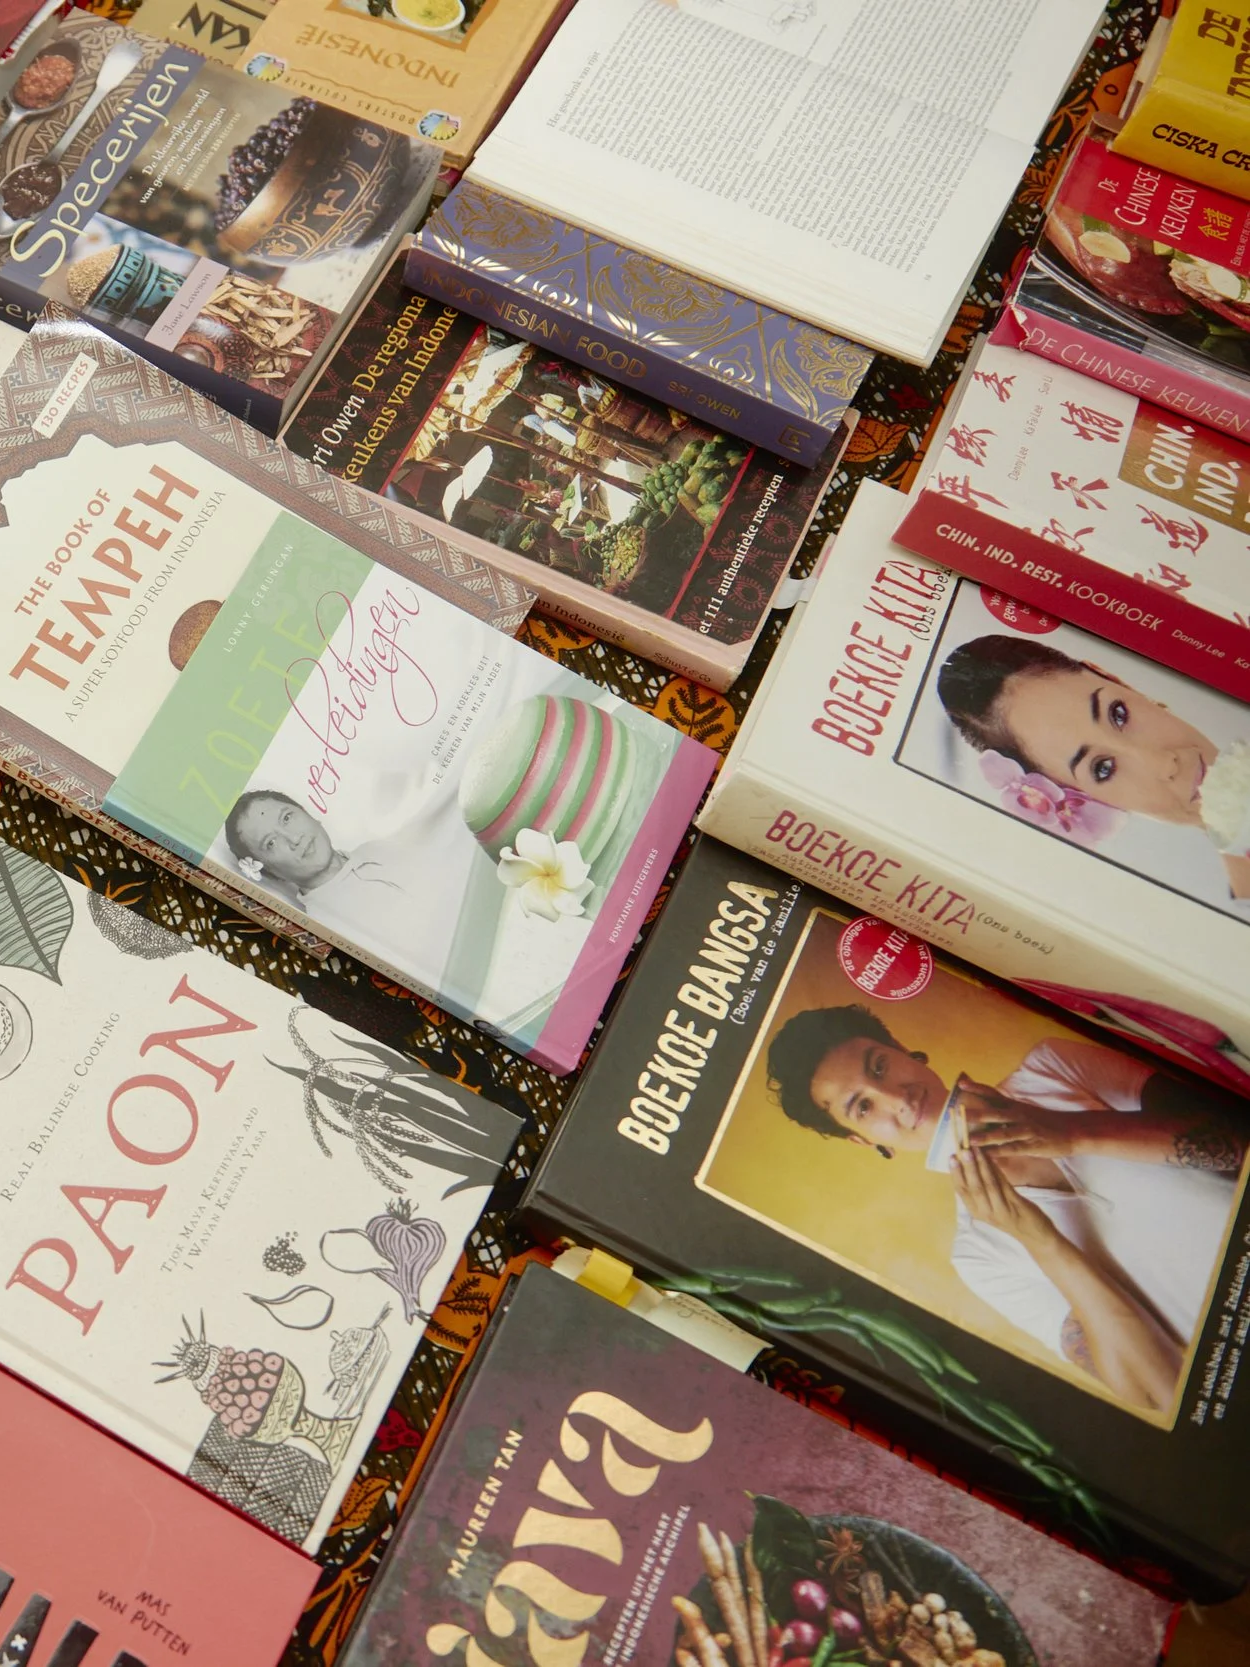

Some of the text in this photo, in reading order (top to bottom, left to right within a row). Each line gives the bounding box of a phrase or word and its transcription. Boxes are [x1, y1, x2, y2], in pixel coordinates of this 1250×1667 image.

[294, 22, 460, 90] INDONESIË
[1197, 8, 1241, 48] DE
[9, 61, 190, 278] Specerijen
[139, 186, 156, 205] van
[141, 158, 159, 176] De
[1098, 177, 1119, 194] DE
[1152, 123, 1219, 160] CISKA
[1114, 166, 1161, 226] CHINESE
[1158, 183, 1198, 241] KEUKEN
[423, 265, 571, 347] INDONESIAN
[575, 332, 648, 380] FOOD
[696, 394, 742, 421] OWEN
[1027, 327, 1247, 432] DE CHINESE KEUKEN
[40, 405, 61, 428] 130
[8, 464, 200, 691] TEMPEH
[14, 487, 112, 618] THE BOOK OF
[65, 488, 227, 722] A SUPER SOYFOOD FROM INDONESIA
[223, 542, 294, 654] LONNY GERUNGAN
[811, 559, 943, 757] BOEKOE KITA
[1066, 580, 1164, 633] KOOKBOEK
[1171, 628, 1206, 655] Danny
[1206, 641, 1227, 659] Lee
[178, 610, 330, 815] ZOETE
[431, 655, 491, 758] CAKES EN KOEKJES UIT
[432, 660, 504, 786] DE KEUKEN VAN MIJN VADER
[17, 770, 76, 811] BOOK
[78, 807, 108, 828] OF
[110, 827, 196, 883] TEMPEH
[609, 848, 659, 944] FONTAINE UITGEVERS
[752, 957, 770, 984] van
[764, 938, 777, 957] de
[618, 881, 779, 1155] BOEKOE BANGSA
[0, 1011, 121, 1204] REAL BALINESE COOKING
[5, 973, 258, 1337] PAON
[160, 1105, 260, 1275] TJOK MAYA KERTHYASA AND
[188, 1213, 221, 1260] WAYAN
[215, 1159, 248, 1212] KRESNA
[241, 1128, 268, 1160] YASA
[447, 1429, 524, 1580] MAUREEN TAN
[135, 1588, 173, 1618] MAS
[620, 1504, 692, 1667] INDONESISCHE ARCHIPEL
[631, 1582, 648, 1610] UIT
[641, 1554, 659, 1584] HET
[651, 1511, 672, 1555] HART
[97, 1588, 193, 1658] VAN PUTTEN
